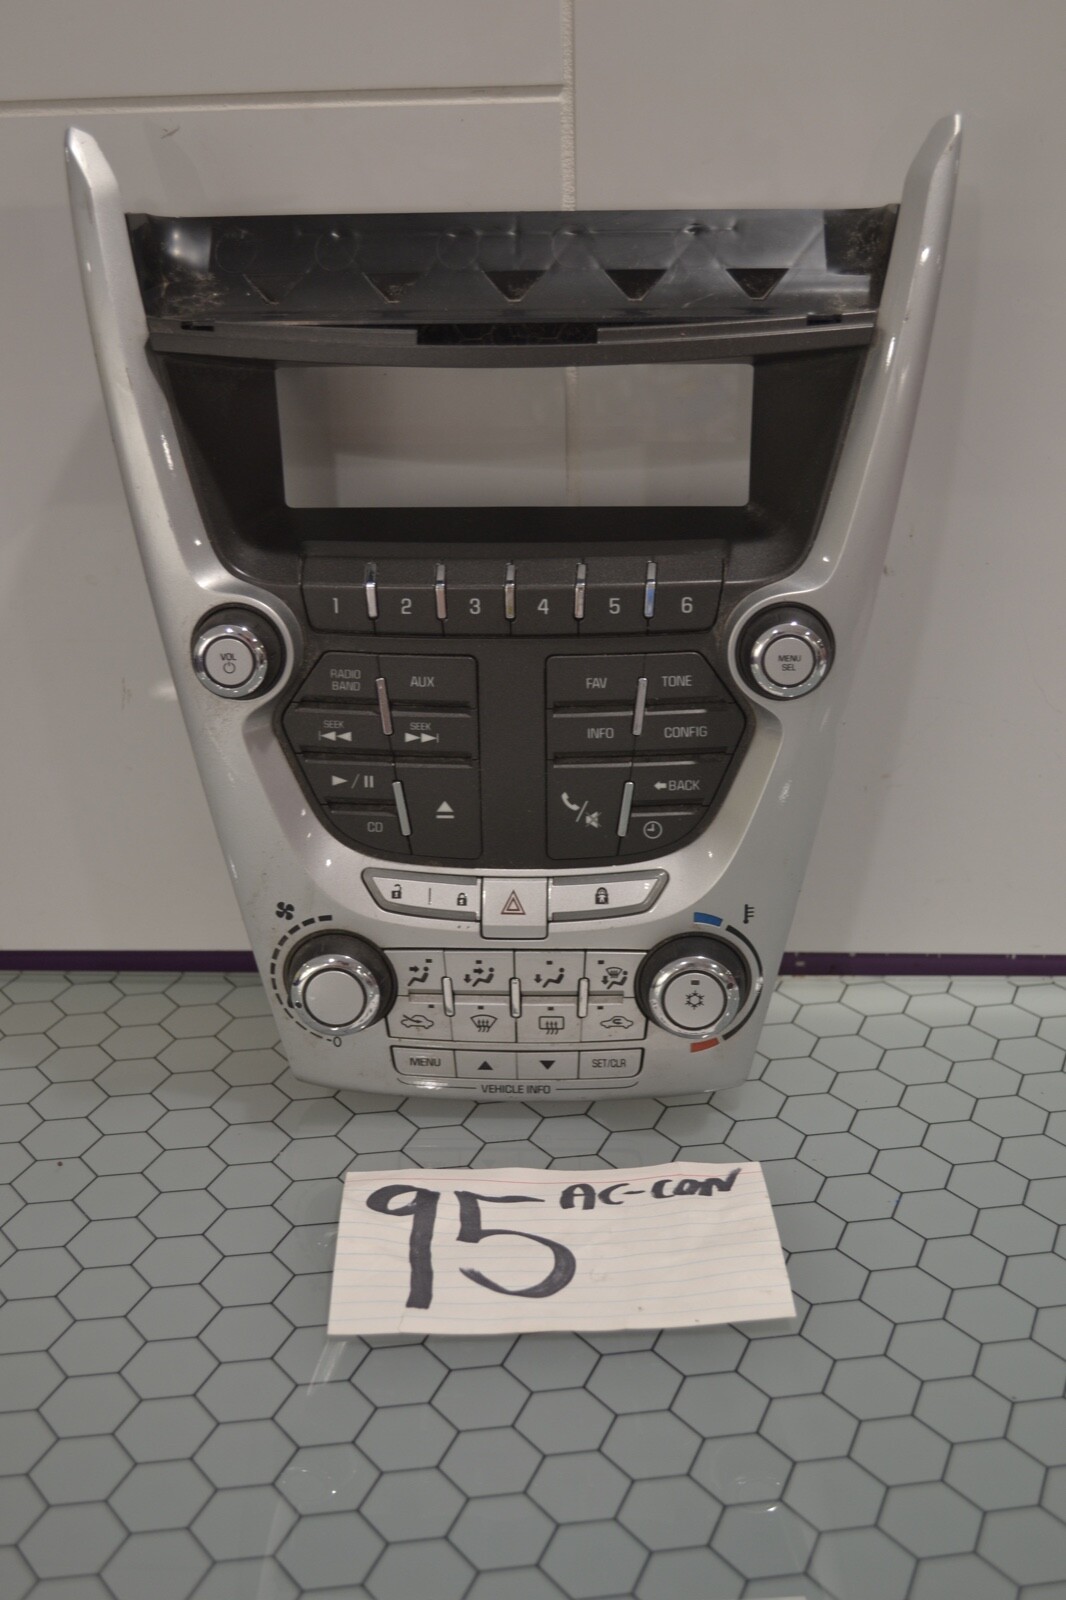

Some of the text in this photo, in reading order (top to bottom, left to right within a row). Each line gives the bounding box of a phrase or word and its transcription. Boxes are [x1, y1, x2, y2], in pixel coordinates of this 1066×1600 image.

[332, 596, 694, 615] 1 2 3 4 5 6
[220, 653, 237, 661] VOL
[778, 654, 802, 662] MENU
[781, 663, 796, 671] SEL
[330, 669, 362, 680] RADIO
[331, 681, 361, 692] BAND
[410, 676, 435, 688] AUX
[586, 677, 608, 689] FAV
[661, 675, 693, 687] TONE
[323, 720, 345, 729] SEEK
[409, 722, 431, 731] SEEK
[587, 728, 615, 739] INFO
[664, 726, 708, 738] CONFIG
[668, 779, 701, 791] BACK
[367, 821, 384, 833] CD
[409, 1056, 441, 1067] MENU
[591, 1058, 627, 1069] SET/CLR
[481, 1084, 551, 1095] VEHICLE INFO
[365, 1183, 577, 1310] 95
